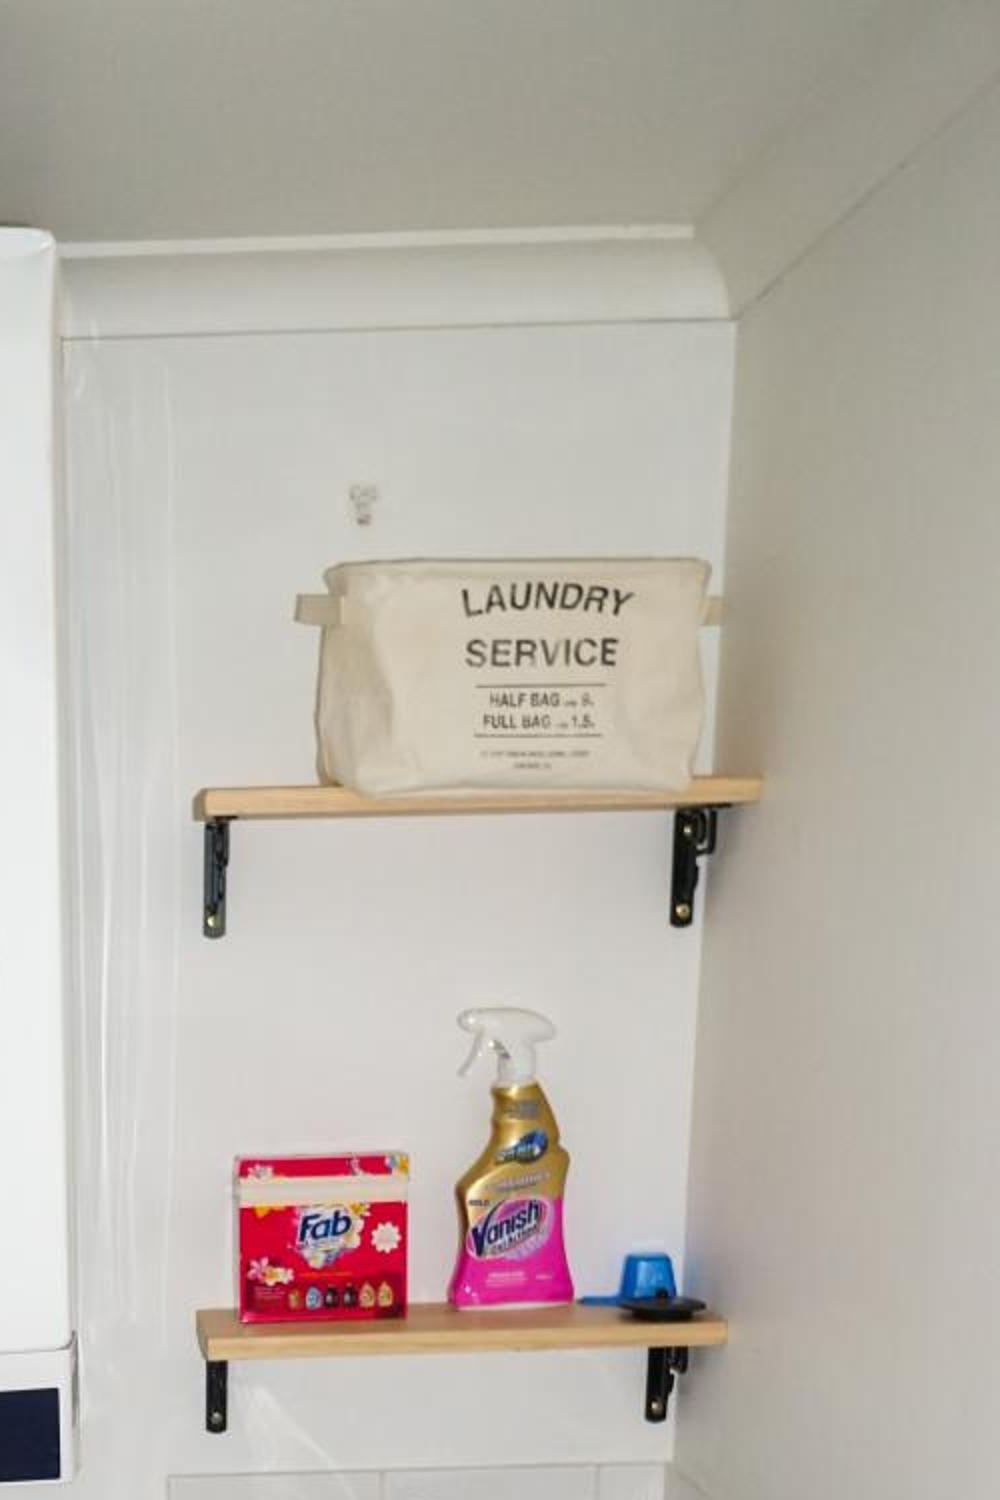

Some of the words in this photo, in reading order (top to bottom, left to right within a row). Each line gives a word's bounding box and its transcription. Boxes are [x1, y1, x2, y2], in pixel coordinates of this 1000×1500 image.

[461, 581, 635, 618] LAUNDRY
[465, 637, 619, 667] SERVICE
[488, 692, 527, 708] HALF
[530, 692, 560, 707] BAG
[483, 714, 517, 729] FULL
[522, 714, 551, 729] BAG
[299, 1210, 352, 1242] Fab
[472, 1198, 541, 1257] Vanish
